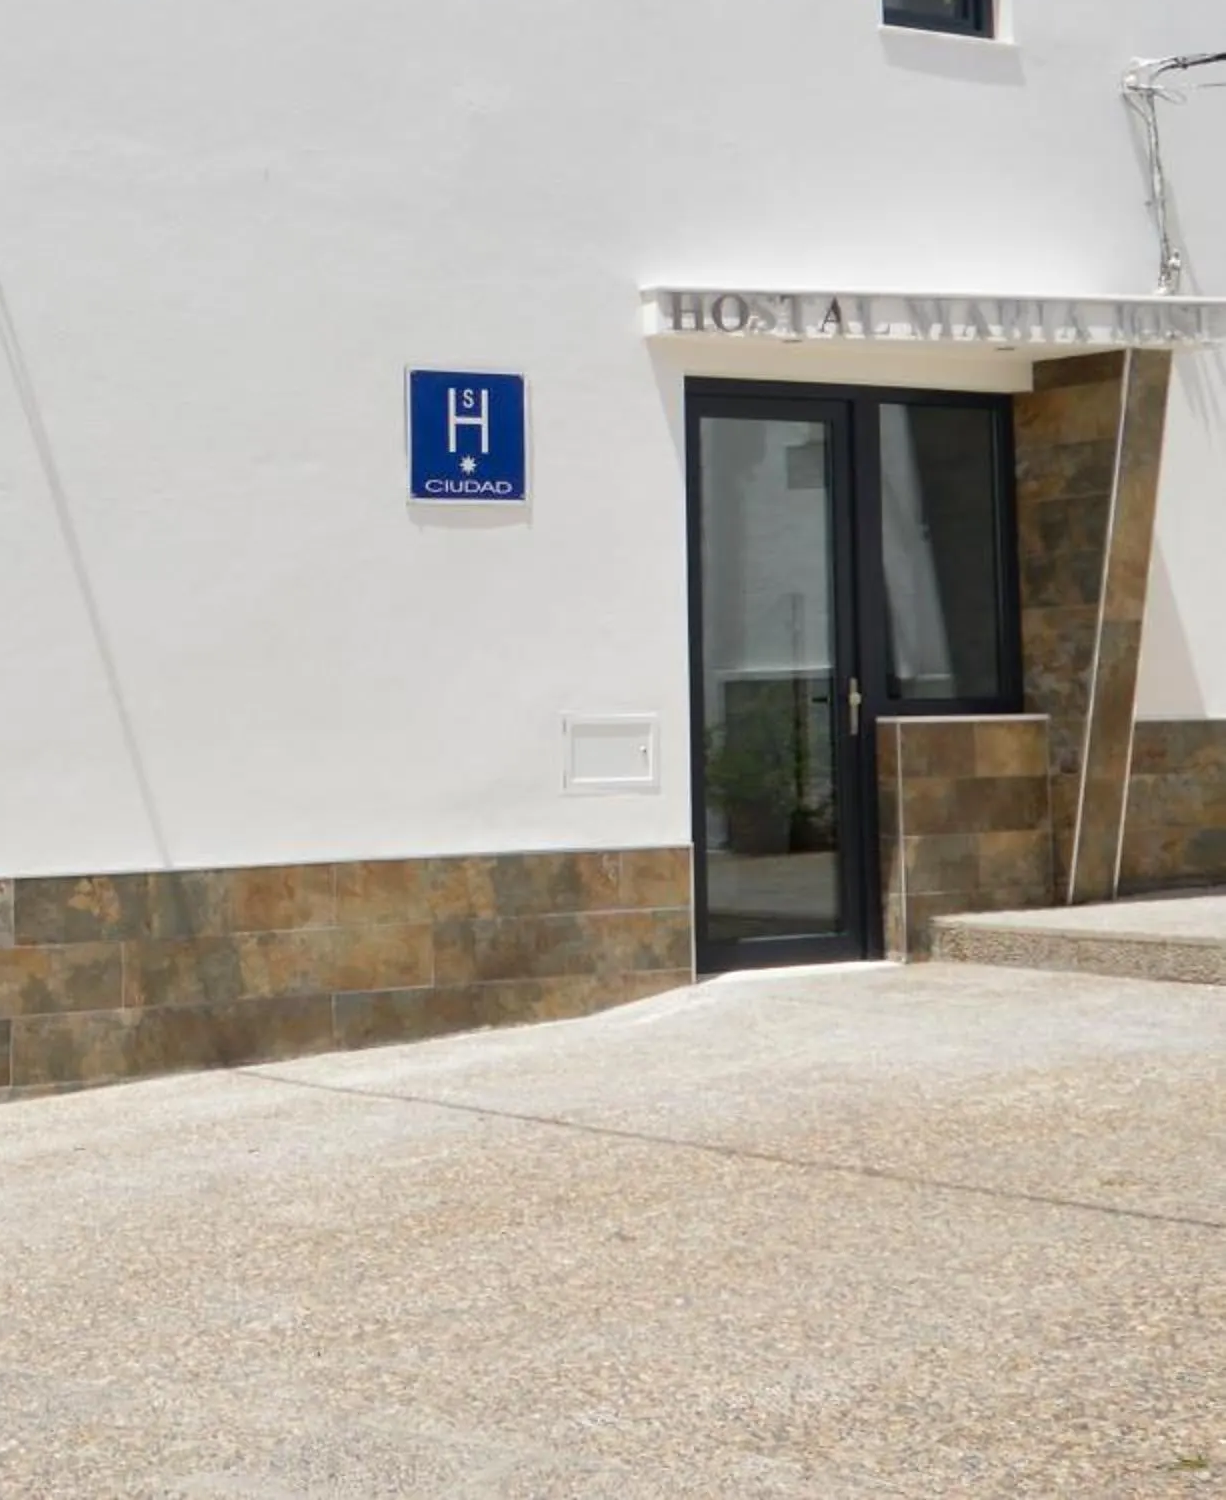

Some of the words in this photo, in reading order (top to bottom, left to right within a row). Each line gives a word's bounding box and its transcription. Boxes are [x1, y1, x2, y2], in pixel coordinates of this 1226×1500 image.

[670, 291, 892, 337] HOSTAL
[462, 388, 475, 409] S
[424, 478, 514, 495] CIUDAD
